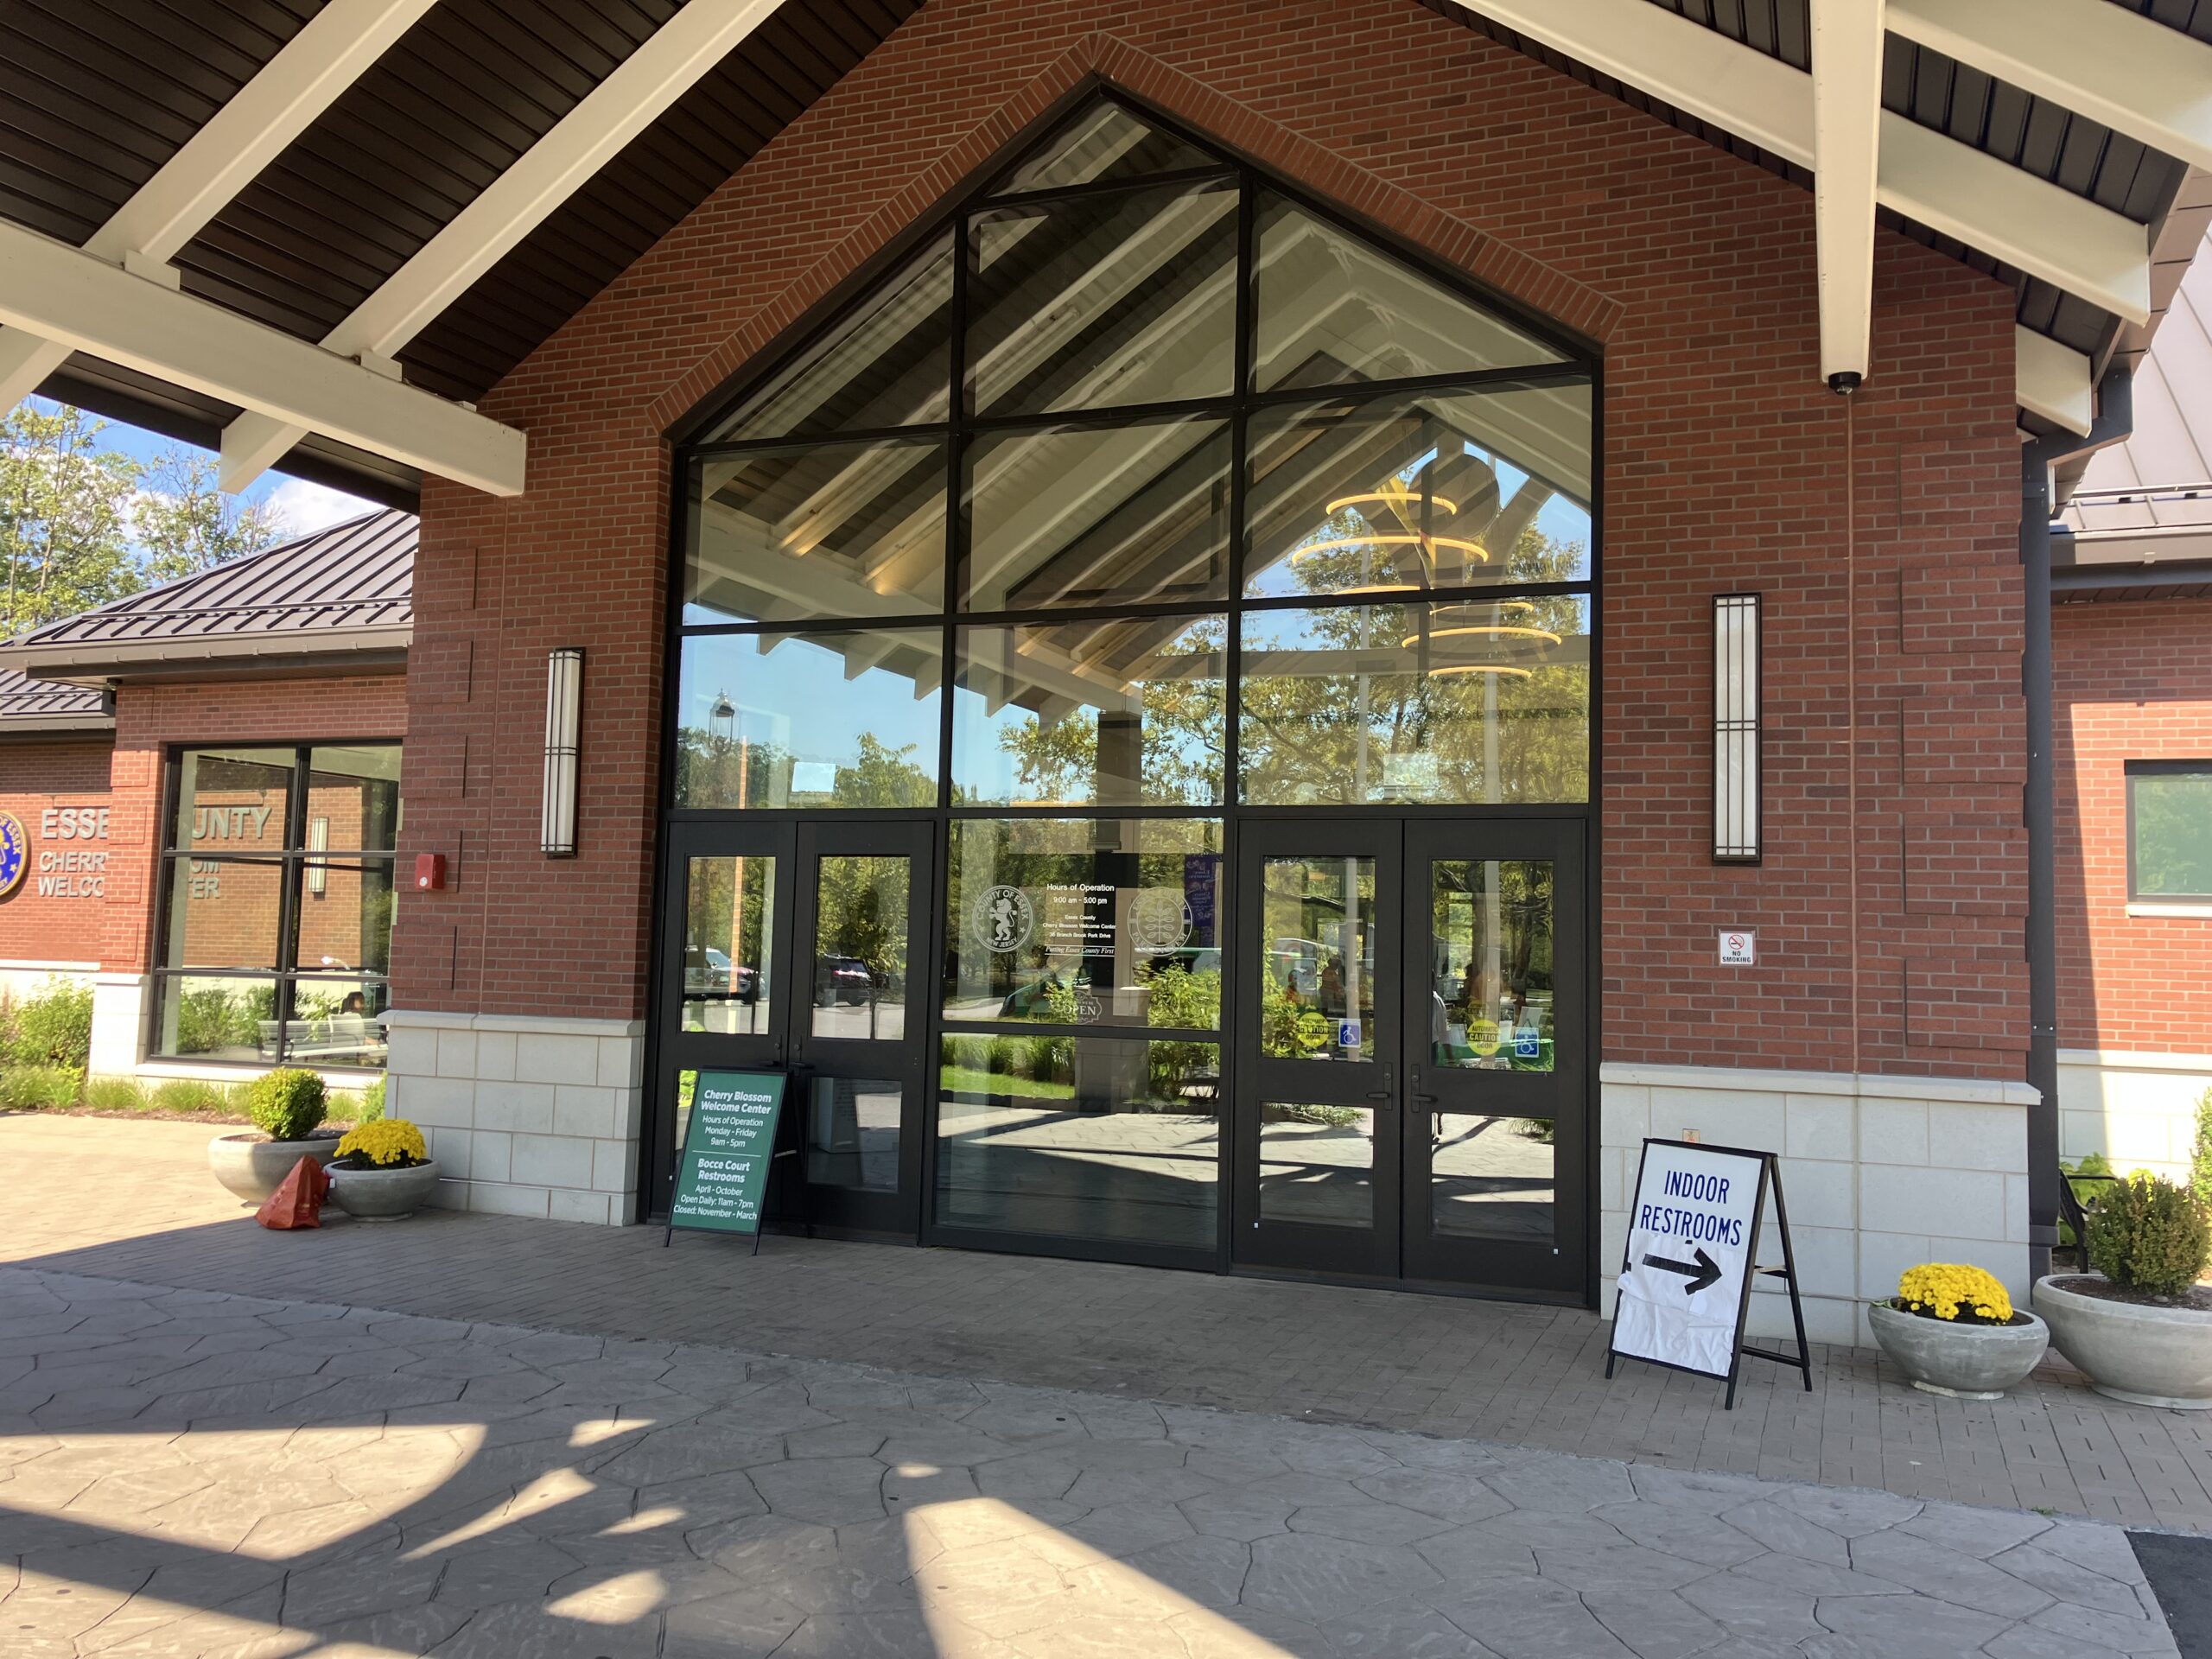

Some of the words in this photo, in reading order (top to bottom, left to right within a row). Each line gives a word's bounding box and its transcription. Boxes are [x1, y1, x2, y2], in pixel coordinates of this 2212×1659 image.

[41, 809, 109, 839] ESSE
[192, 807, 271, 839] UNTY
[39, 851, 109, 872] CHERR
[38, 876, 105, 897] WELCO
[977, 890, 1001, 919] COUNTY
[1002, 890, 1014, 899] OF
[1014, 895, 1028, 919] ESSEX
[1064, 1005, 1096, 1015] OPEN
[1469, 1033, 1497, 1042] CAUTIO
[704, 1090, 733, 1102] Cherry
[734, 1091, 772, 1103] Blossom
[701, 1101, 740, 1112] Welcome
[741, 1103, 771, 1114] Center
[702, 1115, 721, 1124] Hours
[730, 1117, 764, 1127] Operation
[705, 1126, 731, 1136] Monday
[735, 1128, 757, 1138] Friday
[710, 1137, 725, 1146] 9am
[730, 1139, 746, 1147] 5pm
[698, 1158, 723, 1169] Bocce
[725, 1160, 750, 1172] Court
[698, 1170, 746, 1183] Restrooms
[695, 1185, 711, 1193] April
[715, 1186, 743, 1196] October
[1664, 1170, 1730, 1204] INDOOR
[681, 1194, 698, 1204] Open
[698, 1195, 717, 1206] Daily:
[718, 1198, 733, 1206] 11am
[738, 1199, 753, 1209] 7pm
[674, 1205, 696, 1214] Closed:
[697, 1207, 732, 1217] November
[736, 1211, 757, 1220] March
[1640, 1205, 1742, 1246] RESTROOMS
